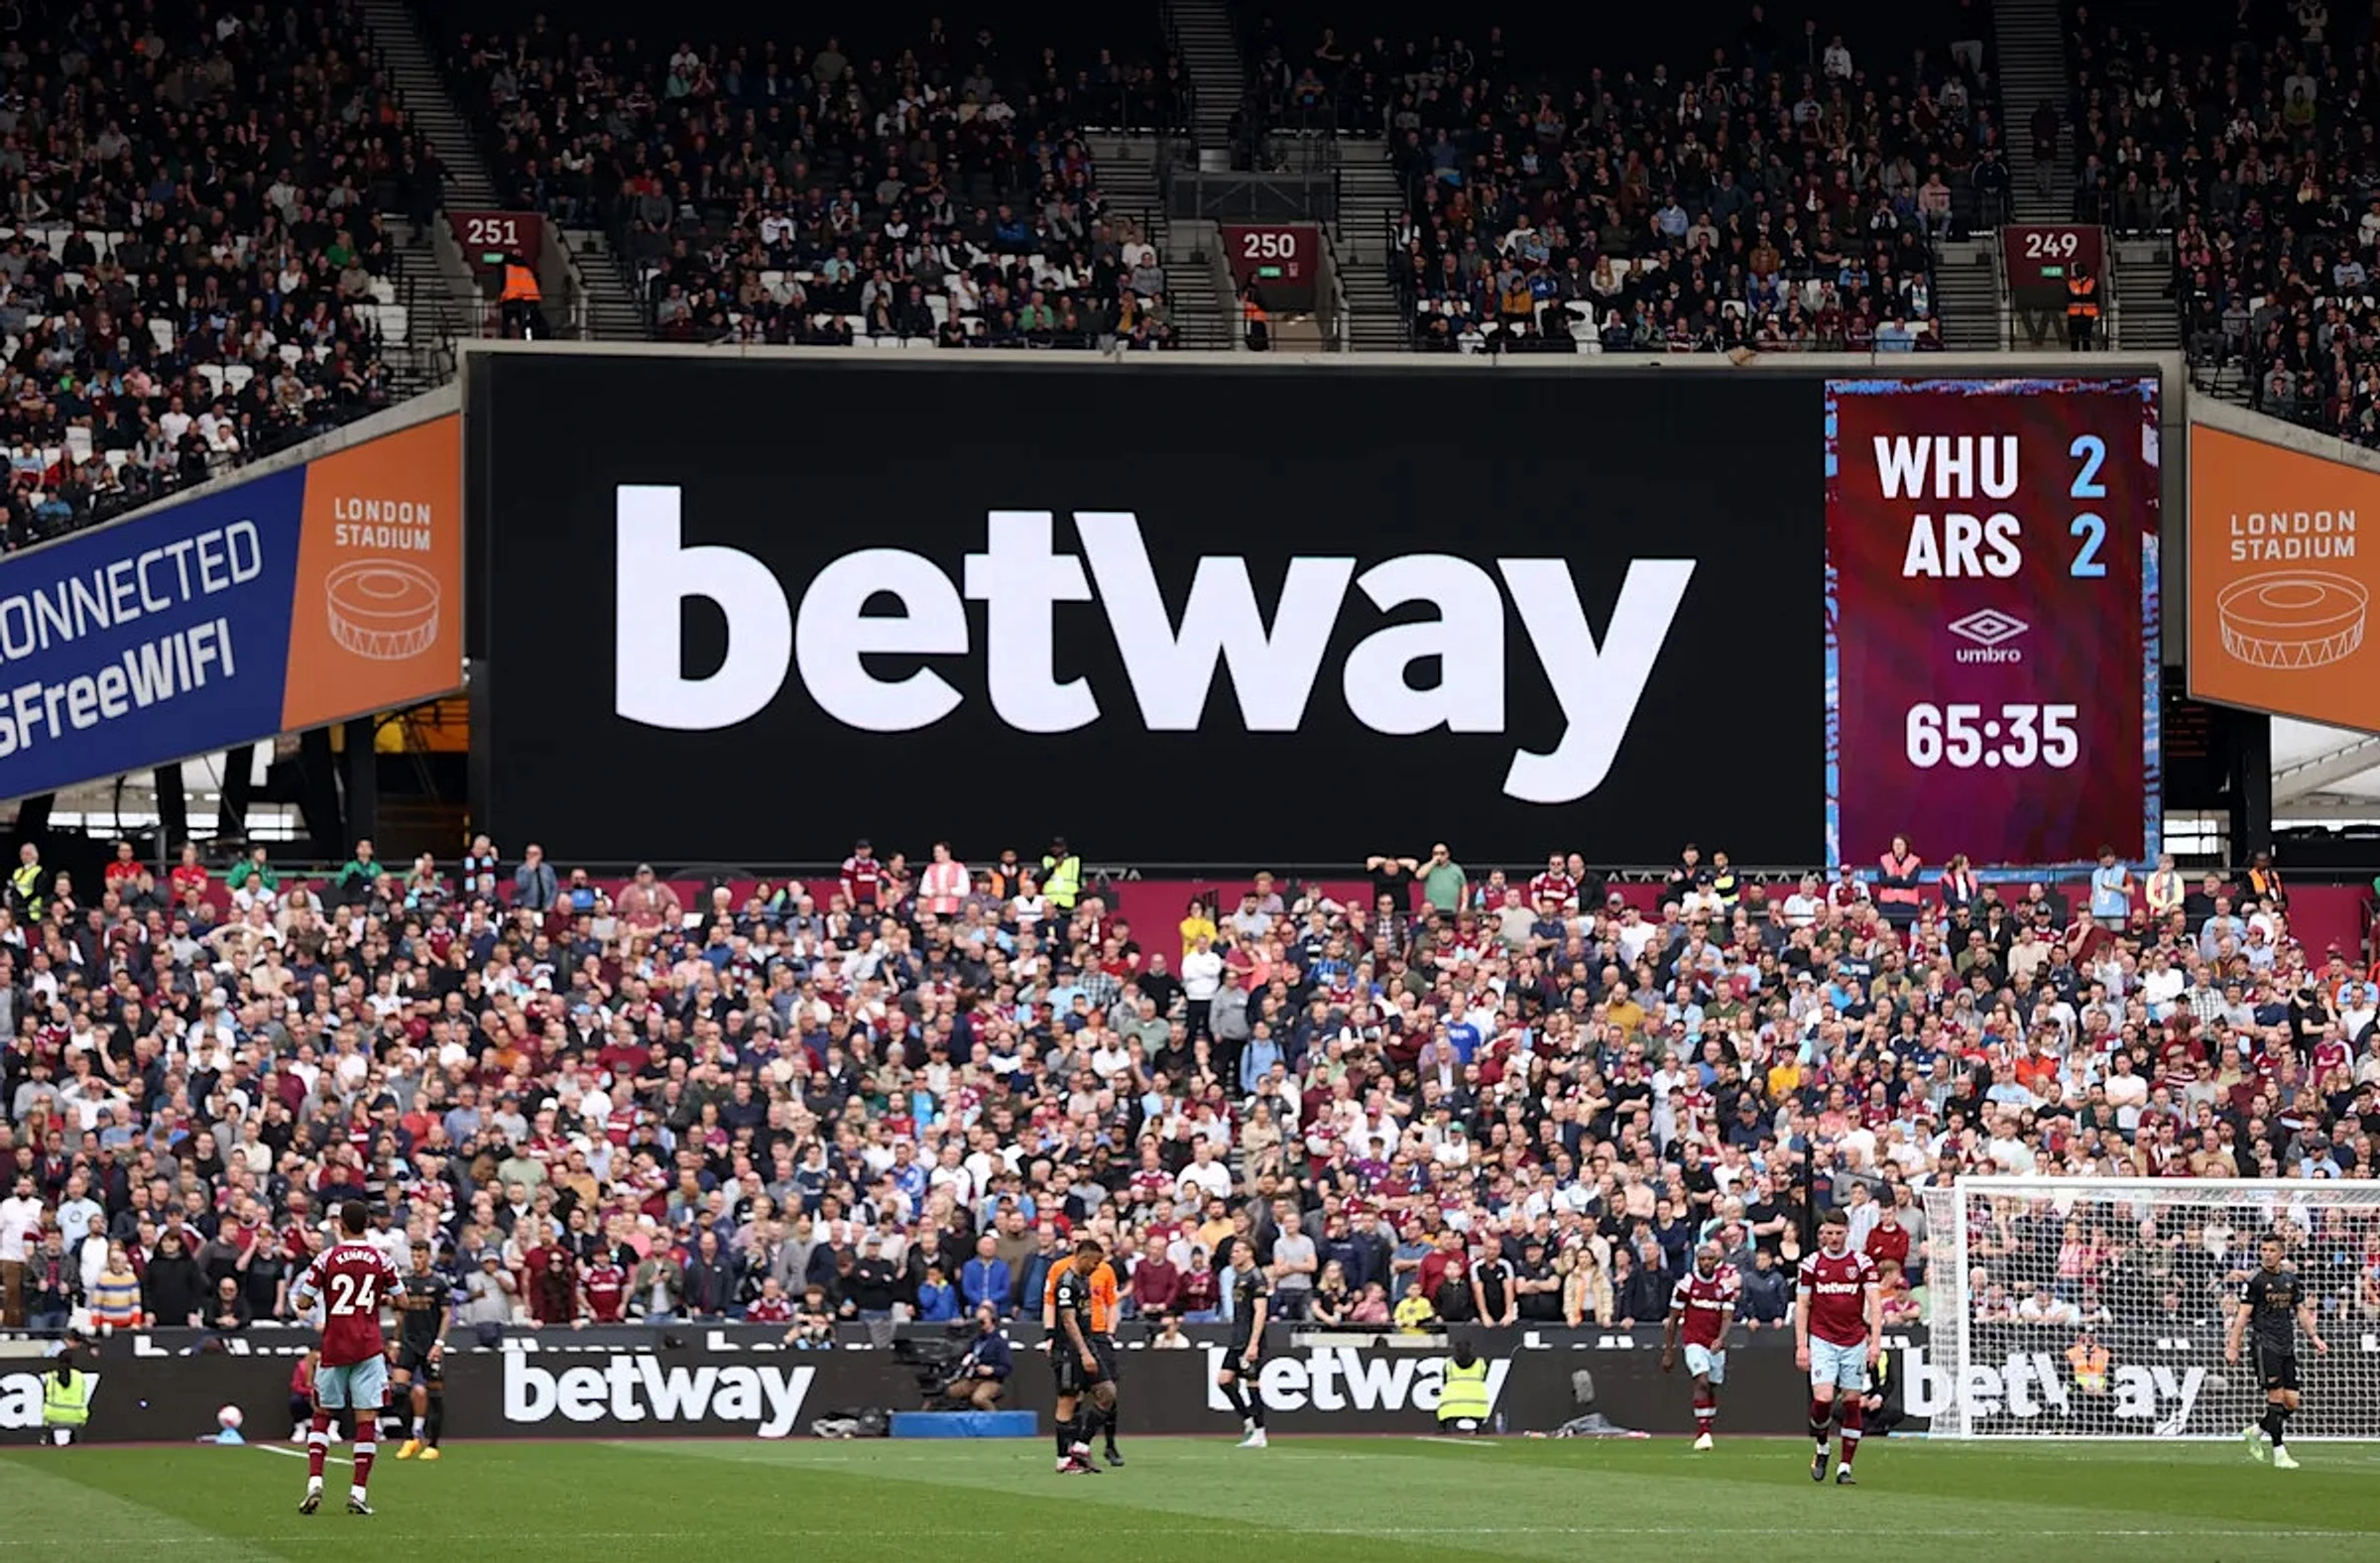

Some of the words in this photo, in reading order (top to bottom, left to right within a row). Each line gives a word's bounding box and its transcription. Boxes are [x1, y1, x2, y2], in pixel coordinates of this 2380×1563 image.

[467, 218, 519, 245] 251
[1243, 233, 1296, 259] 250
[2025, 232, 2079, 258] 249
[1872, 435, 2018, 499] WHU
[2069, 434, 2106, 498] 2
[334, 496, 431, 526] LONDON
[2230, 509, 2356, 537] LONDON
[334, 523, 431, 551] STADIUM
[1901, 513, 2022, 577] ARS
[2069, 512, 2106, 577] 2
[2230, 536, 2356, 561] STADIUM
[0, 519, 263, 664] ONNECTED
[616, 484, 1698, 803] betway
[1956, 646, 2022, 663] umbro
[1905, 702, 2080, 768] 65:35
[330, 1272, 376, 1315] 24
[1816, 1281, 1859, 1295] betway
[503, 1351, 817, 1438] betway
